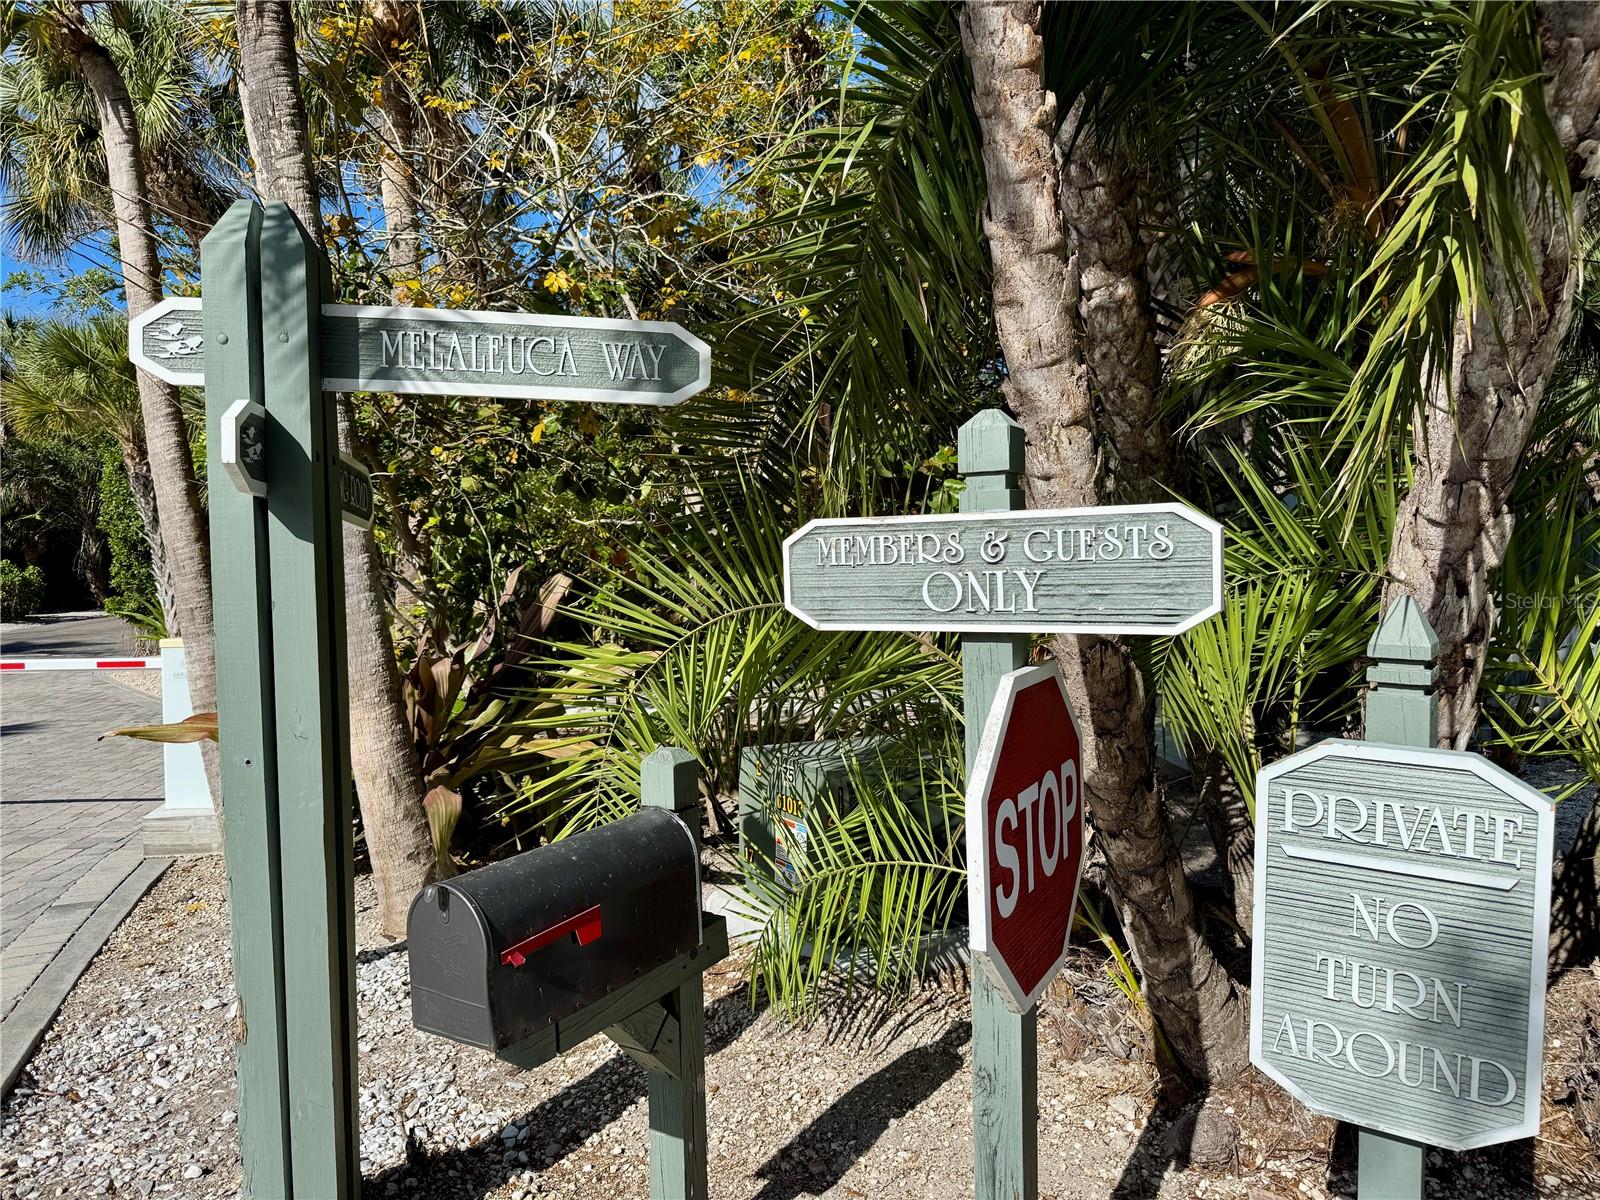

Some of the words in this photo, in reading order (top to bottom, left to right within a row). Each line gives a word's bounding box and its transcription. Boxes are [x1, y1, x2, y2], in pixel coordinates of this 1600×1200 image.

[379, 329, 579, 377] MELALEUCA
[600, 341, 667, 382] WAY
[816, 530, 965, 568] MEMBERS
[980, 529, 1009, 564] &
[1023, 522, 1175, 563] GUESTS
[922, 567, 1043, 614] ONLY
[994, 758, 1077, 919] STOP
[1280, 788, 1524, 870] PRIVATE
[1350, 893, 1439, 949] NO
[1316, 951, 1469, 1028] TURN
[1270, 1012, 1518, 1107] AROUND
